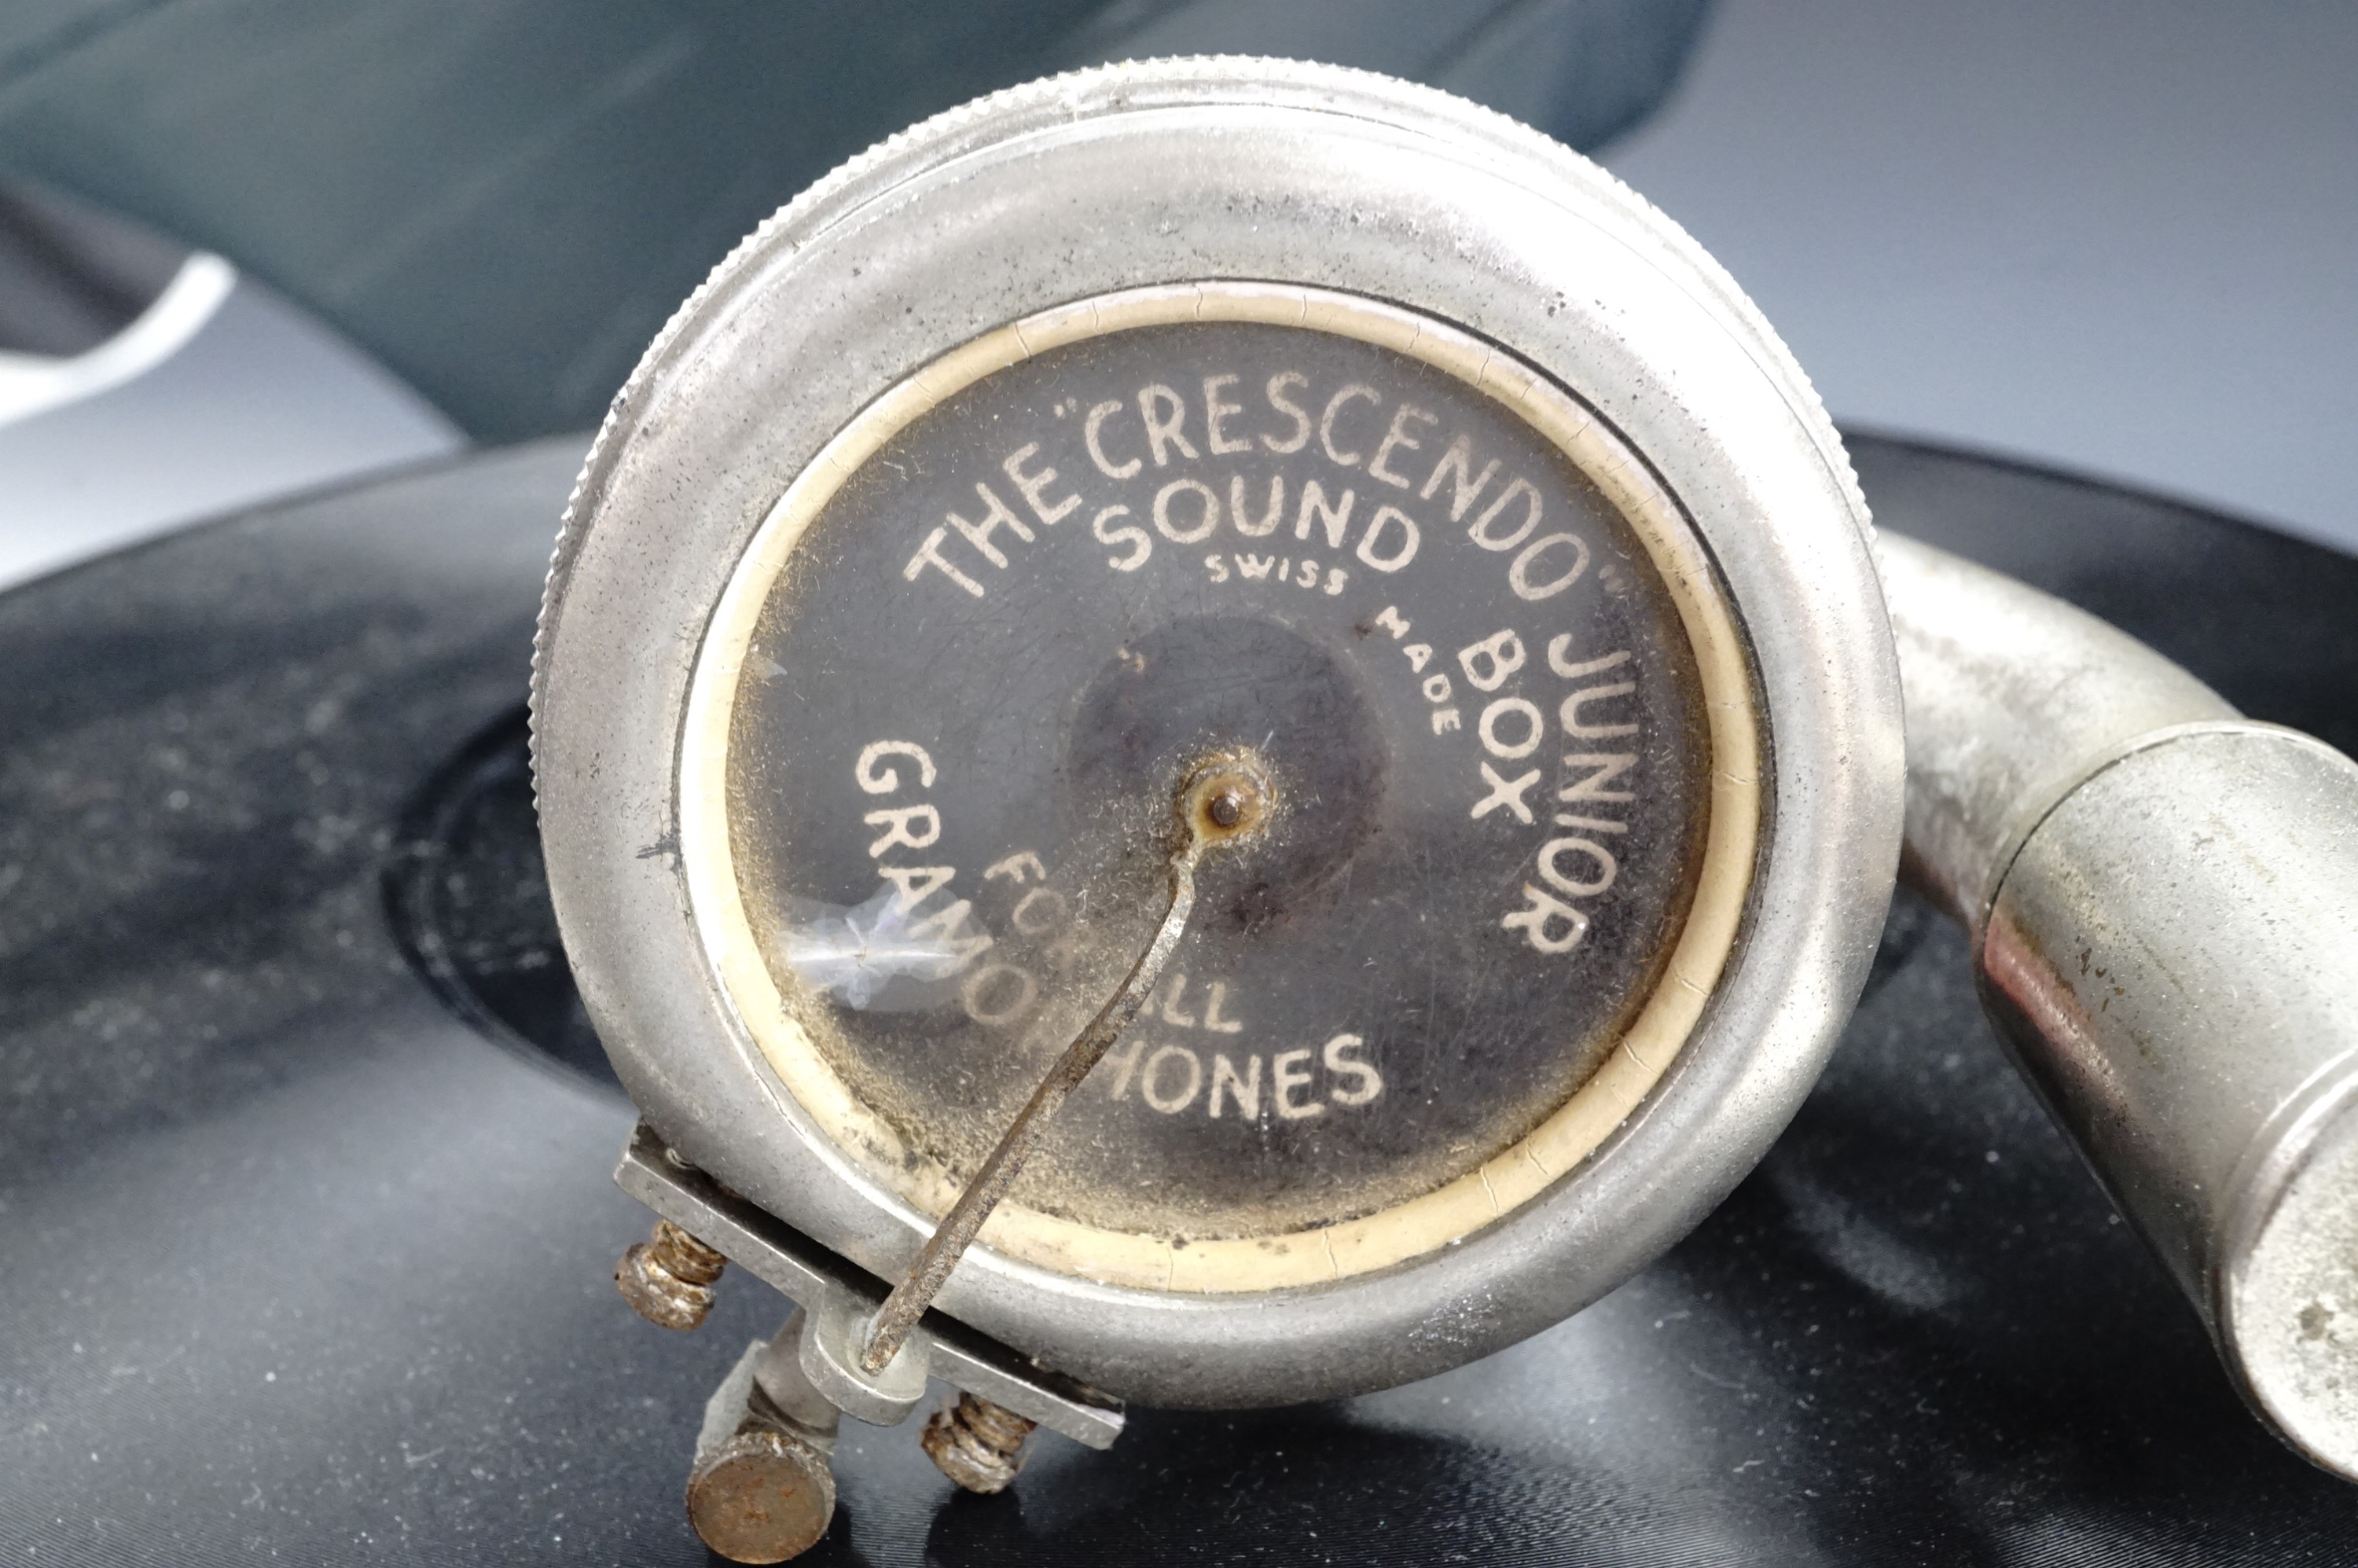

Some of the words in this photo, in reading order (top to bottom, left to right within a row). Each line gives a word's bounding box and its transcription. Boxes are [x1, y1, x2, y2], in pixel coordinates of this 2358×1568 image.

[903, 442, 1082, 597] THE
[1501, 633, 1639, 953] JUNIOR
[1093, 475, 1420, 573] SOUND
[1458, 629, 1544, 824] BOX
[1205, 553, 1348, 596] SWISS
[1376, 605, 1461, 736] MADE
[855, 739, 1383, 1121] GRAMOHONES
[1140, 973, 1243, 1033] LL
